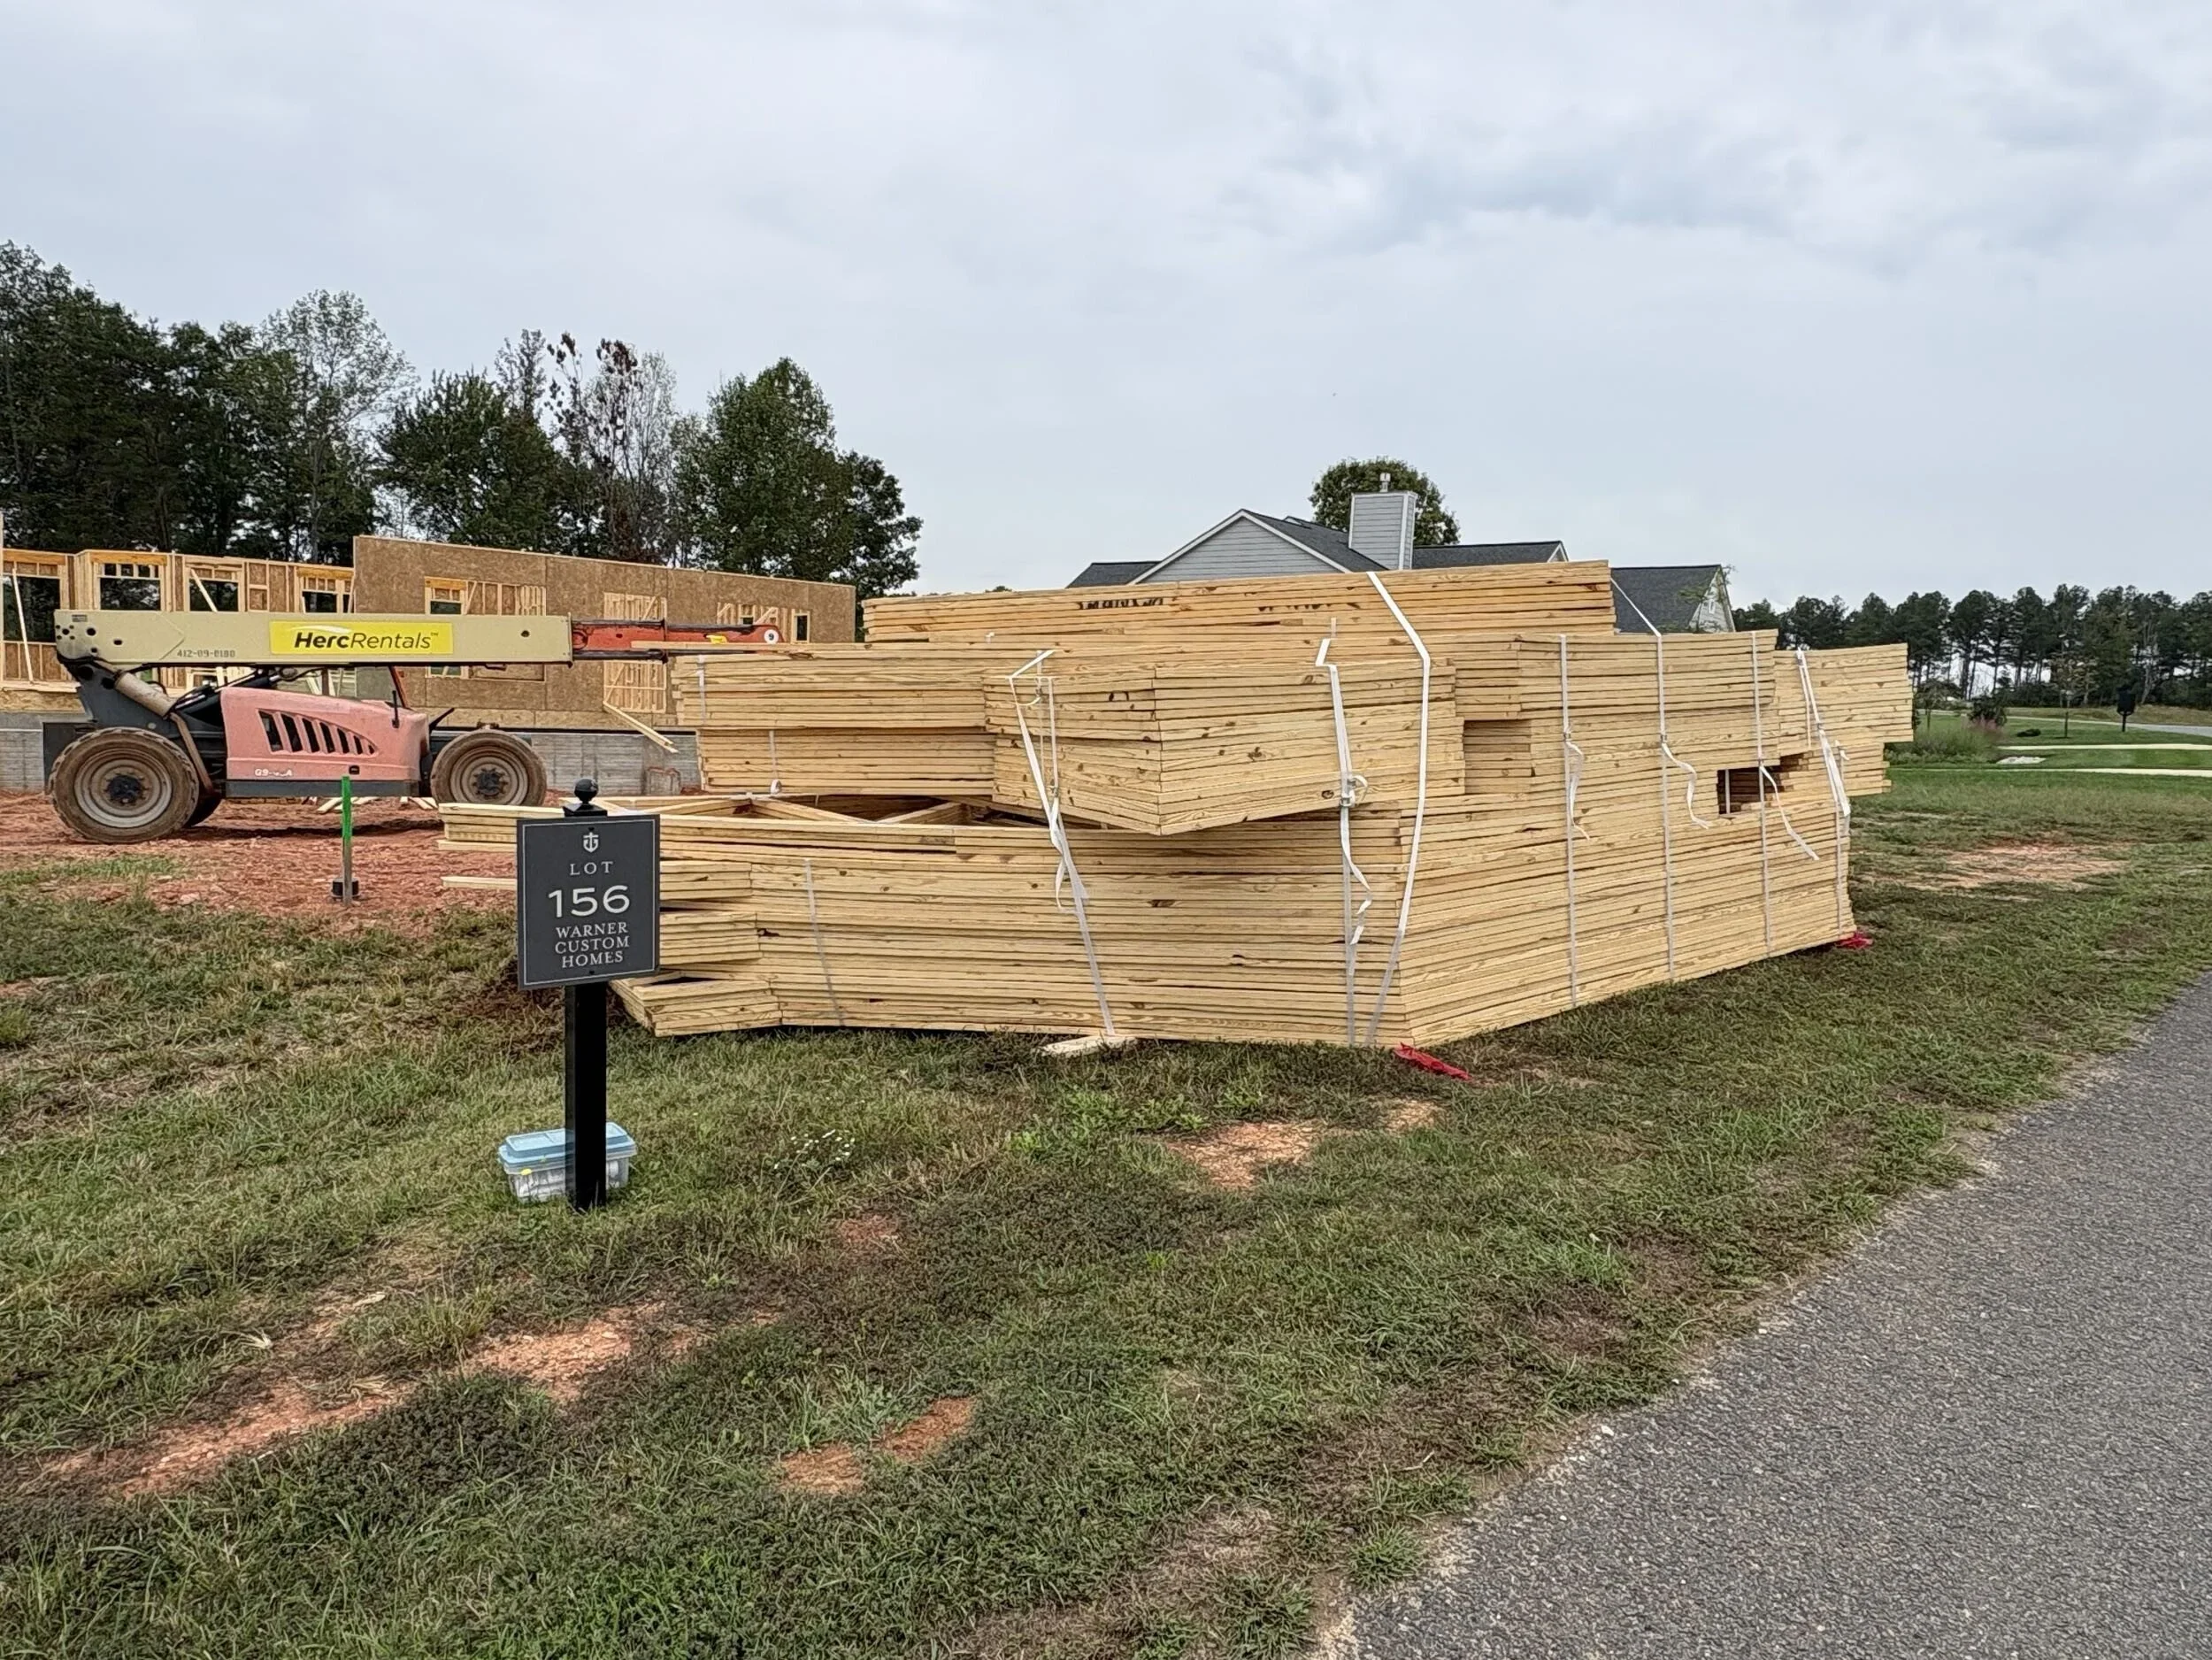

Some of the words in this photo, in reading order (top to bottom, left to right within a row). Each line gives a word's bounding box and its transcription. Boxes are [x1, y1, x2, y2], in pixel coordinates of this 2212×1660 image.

[570, 861, 614, 875] LOT
[548, 885, 630, 918] 156
[556, 922, 629, 938] WARNER
[555, 936, 630, 954] CUSTOM
[561, 951, 624, 969] HOMES
